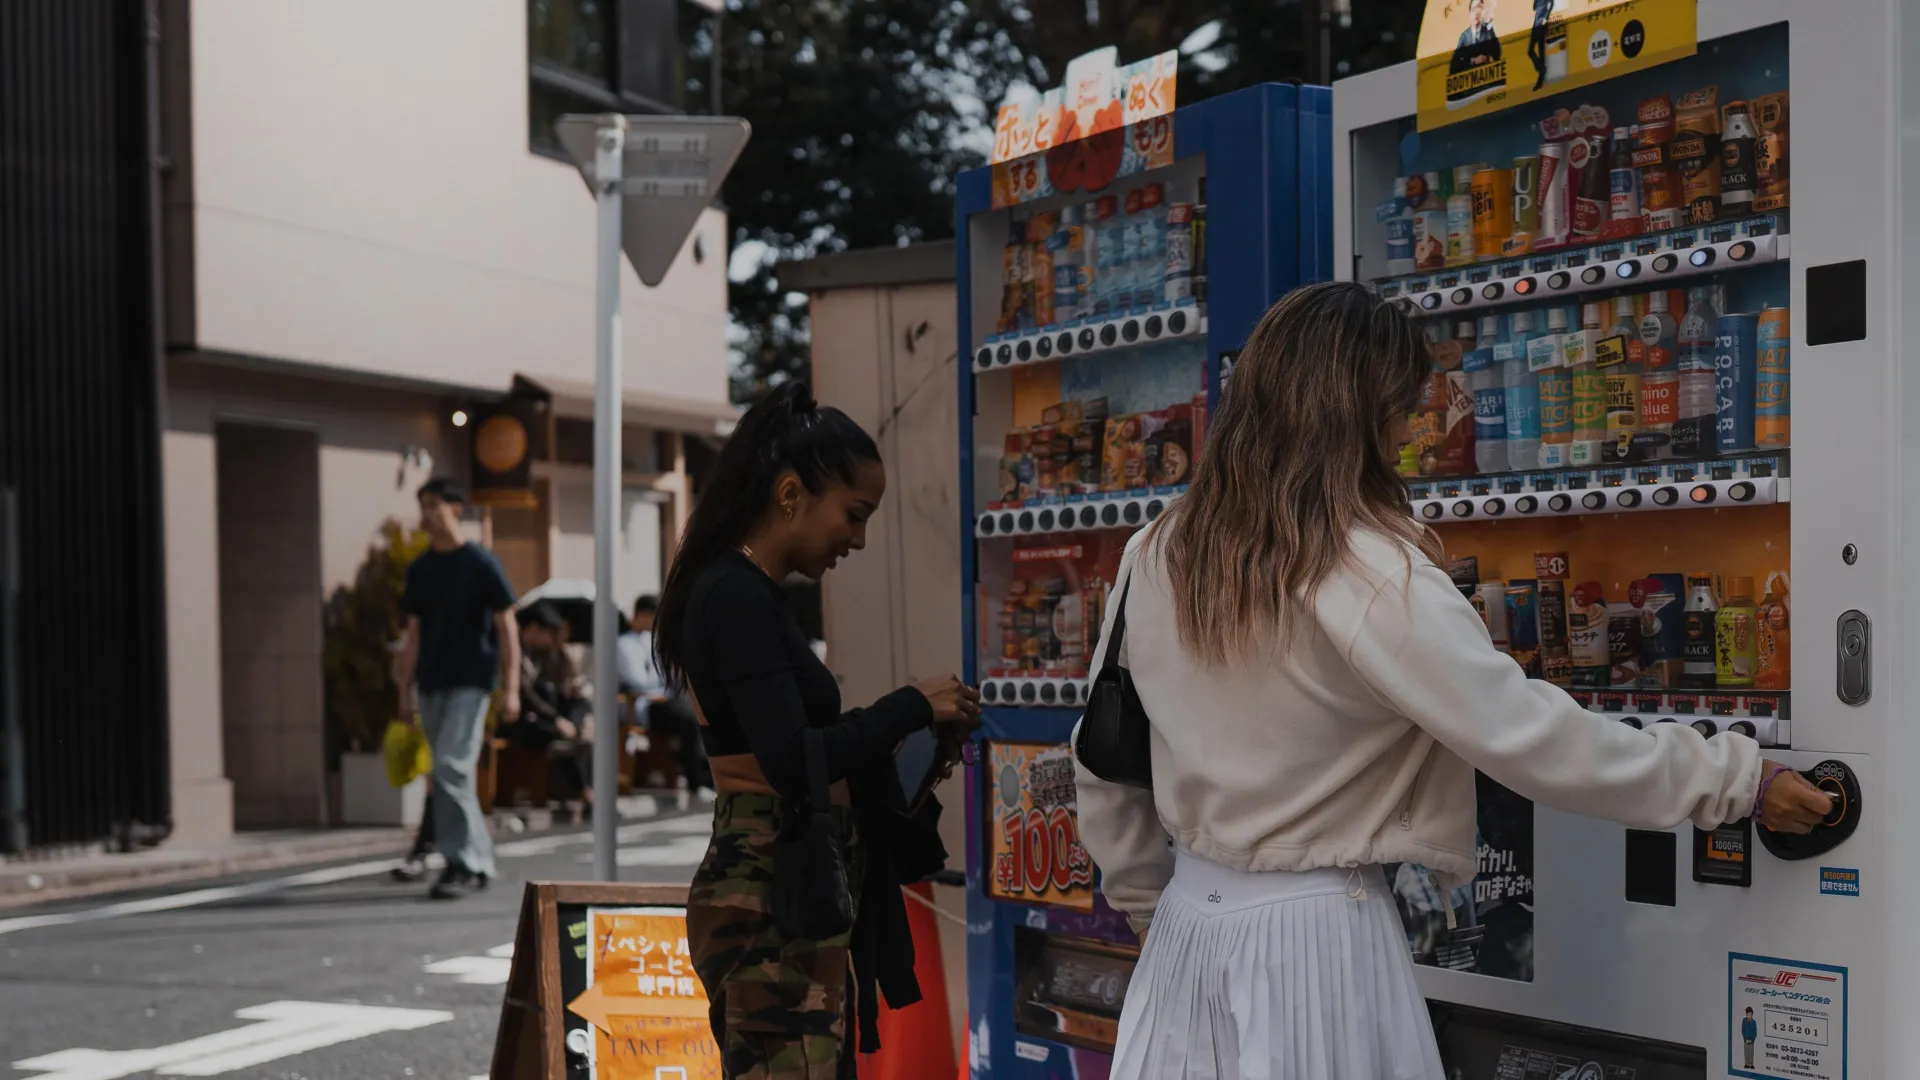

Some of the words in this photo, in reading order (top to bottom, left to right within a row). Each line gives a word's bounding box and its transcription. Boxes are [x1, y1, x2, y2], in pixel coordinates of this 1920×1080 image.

[1671, 143, 1701, 156] WONDA
[1632, 151, 1658, 164] WONDA
[1720, 336, 1736, 444] POCARI
[1821, 881, 1859, 892] 使用できません
[1208, 889, 1221, 903] alo
[1771, 1023, 1818, 1037] 425201
[683, 1037, 715, 1057] OU
